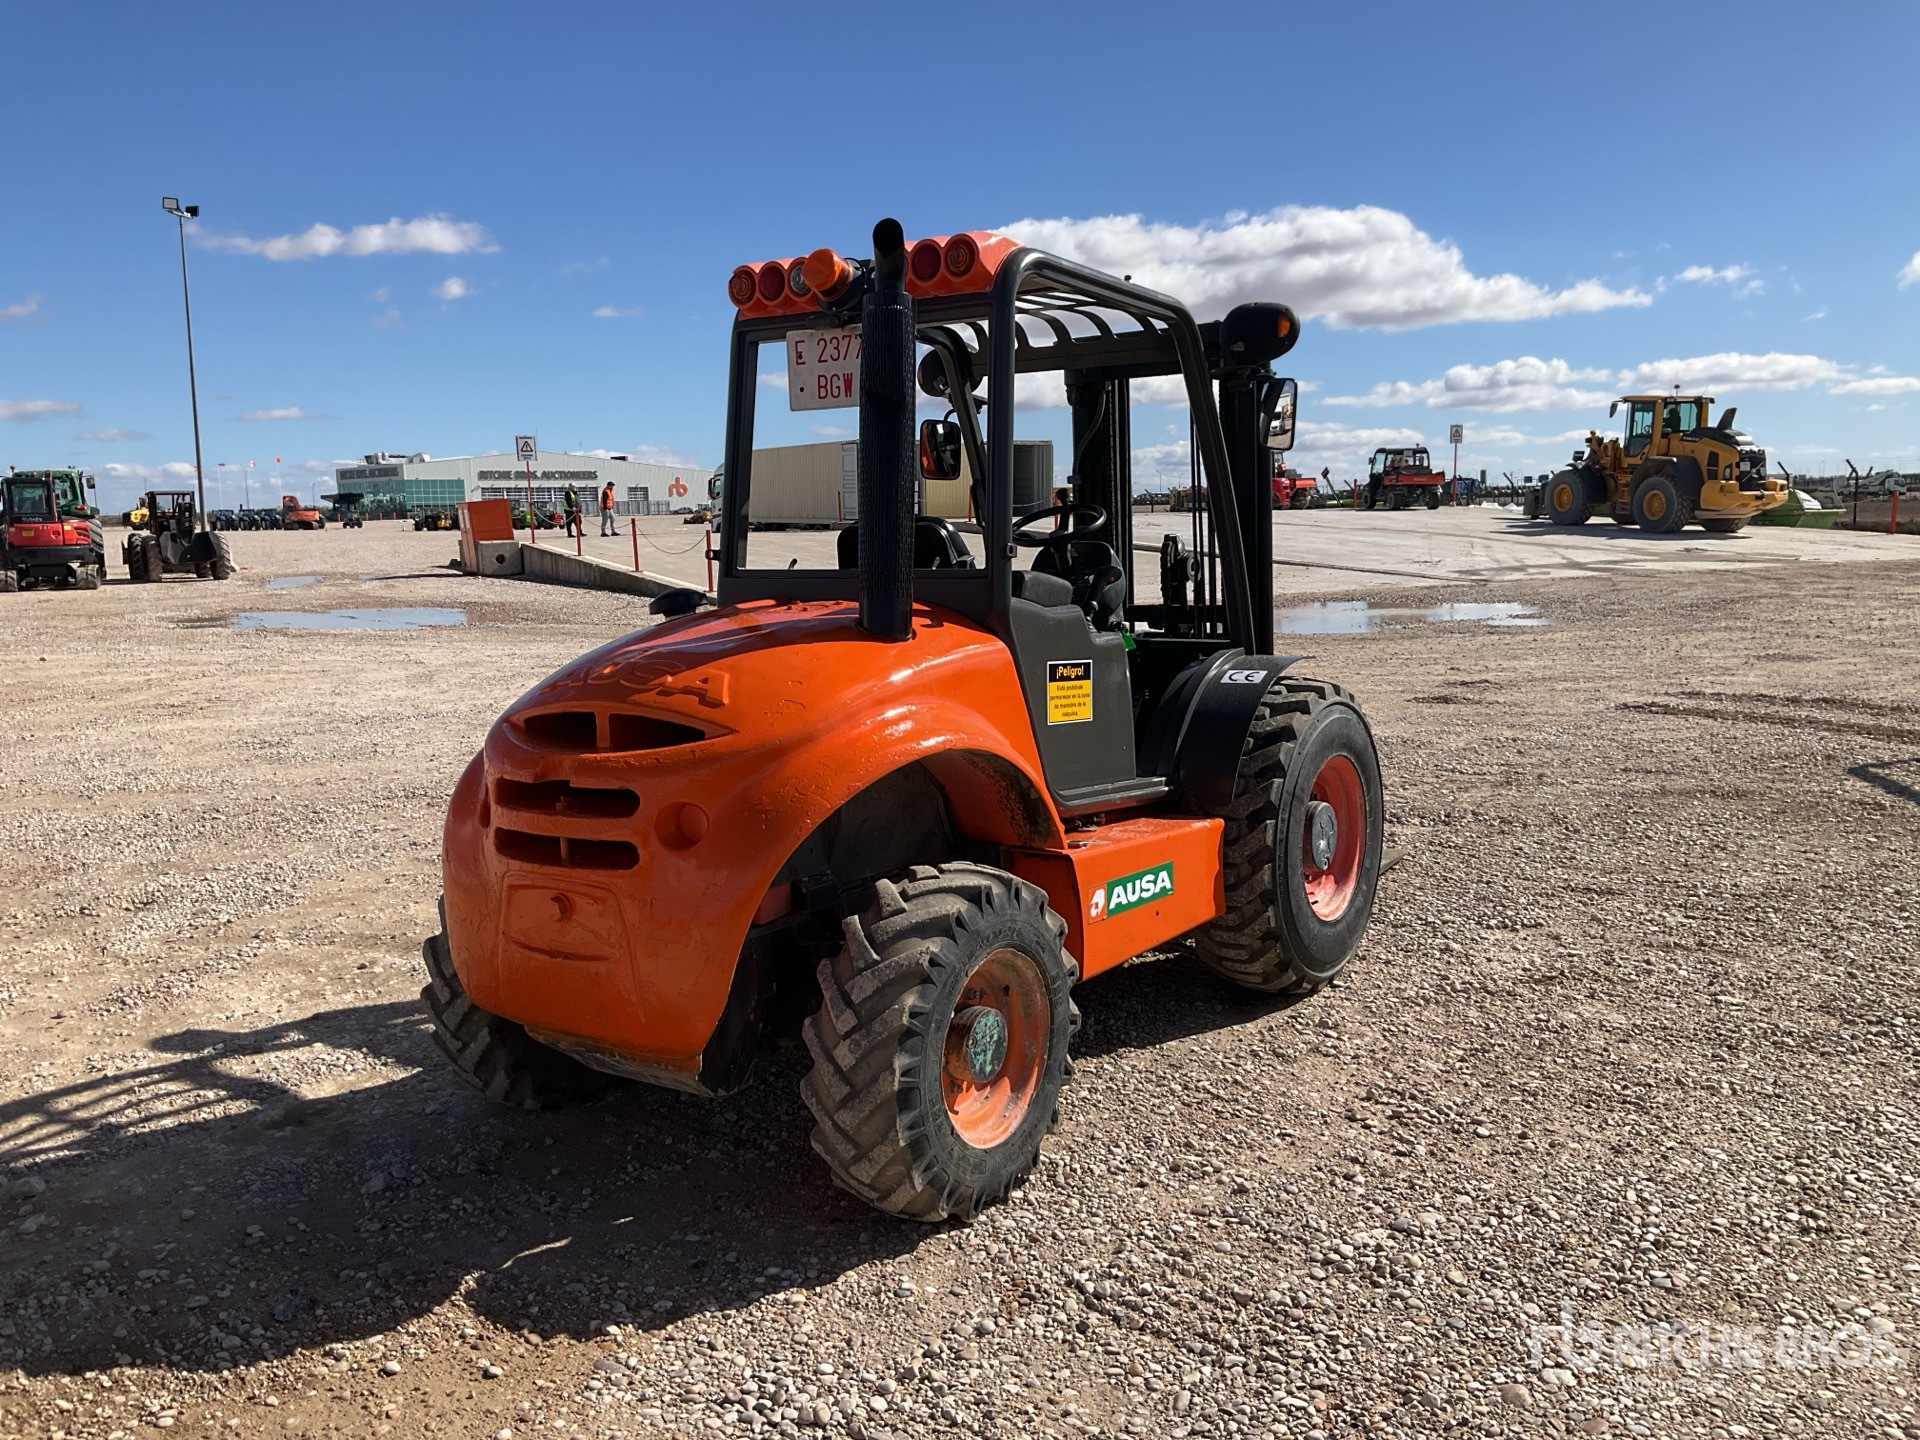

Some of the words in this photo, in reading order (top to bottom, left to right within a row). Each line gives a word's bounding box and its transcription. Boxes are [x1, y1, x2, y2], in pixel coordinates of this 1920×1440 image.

[795, 339, 806, 366] E
[816, 333, 862, 364] 2377
[817, 372, 853, 399] BGW
[1056, 665, 1084, 679] ¡Peligro!
[1228, 671, 1260, 682] CE
[1108, 870, 1172, 910] AUSA
